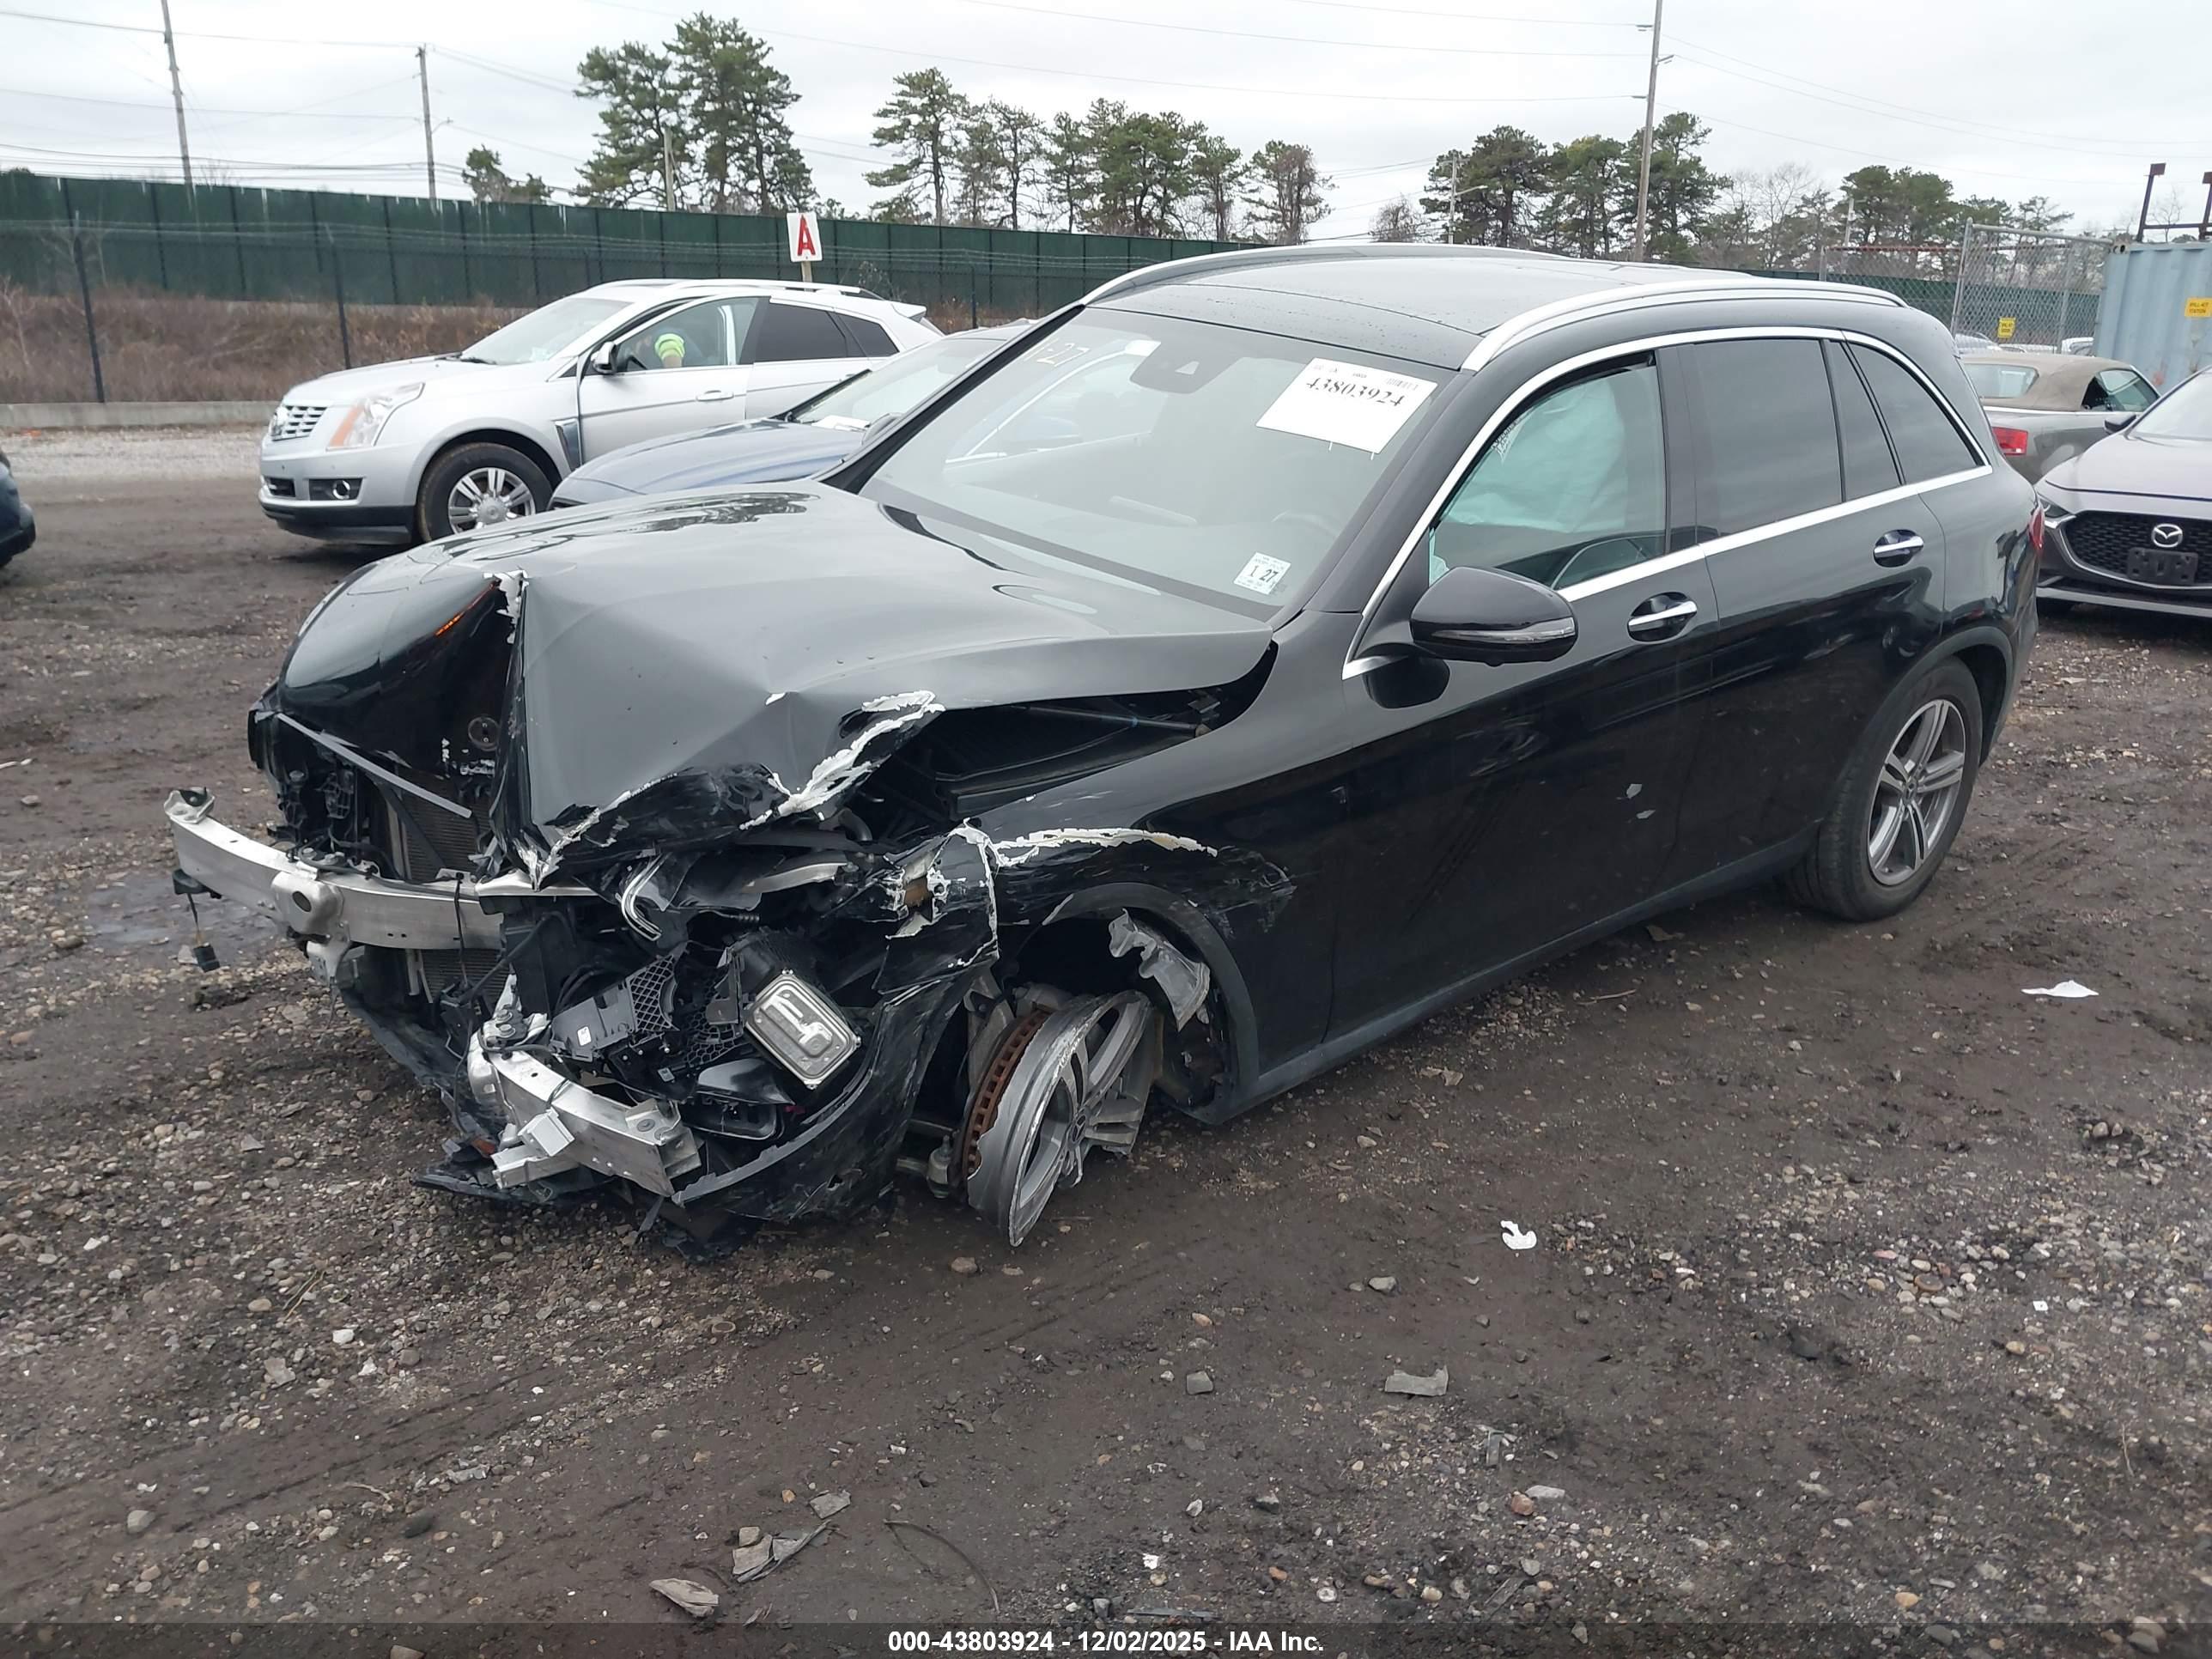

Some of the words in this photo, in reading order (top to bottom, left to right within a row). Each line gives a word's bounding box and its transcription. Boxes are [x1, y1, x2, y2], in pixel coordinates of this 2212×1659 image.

[797, 215, 817, 257] A
[1306, 377, 1406, 407] 43803924
[1259, 568, 1279, 583] 27
